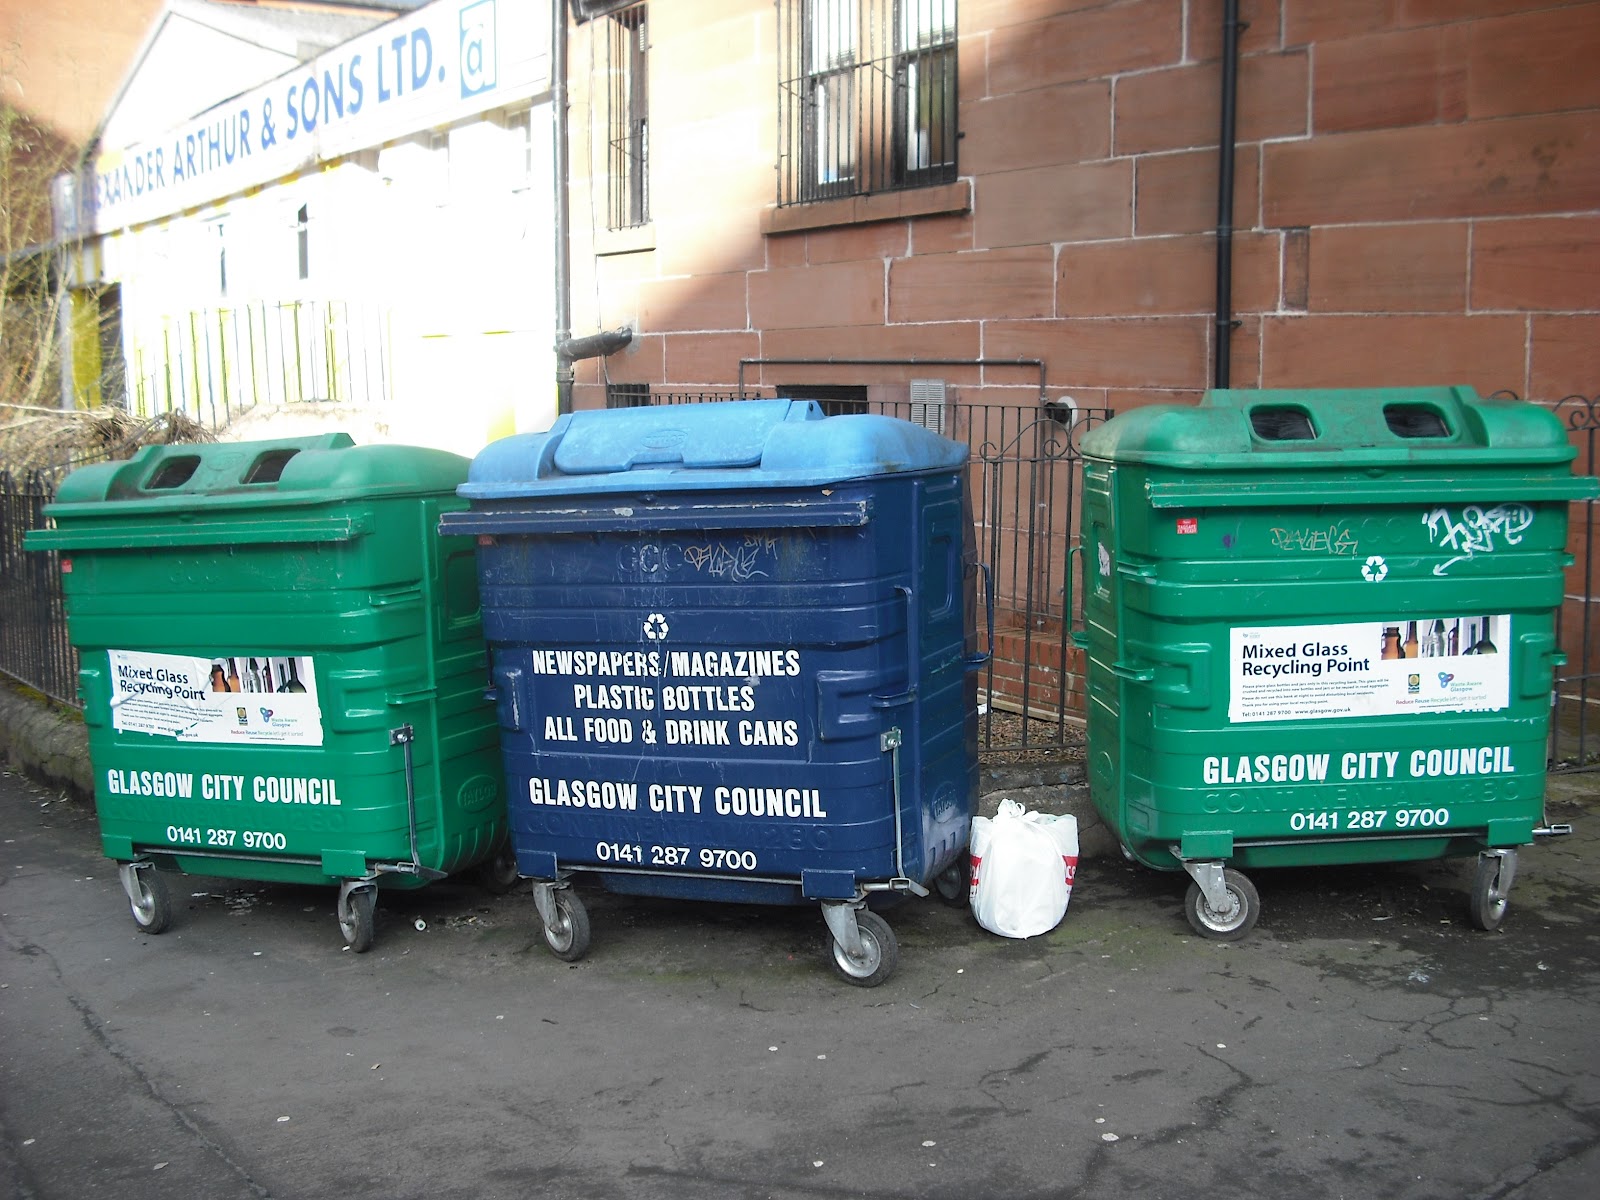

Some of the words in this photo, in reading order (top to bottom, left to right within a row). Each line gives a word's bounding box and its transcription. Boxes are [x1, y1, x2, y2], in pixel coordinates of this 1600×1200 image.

[173, 109, 251, 185] ARTHUR
[260, 97, 277, 151] &
[286, 55, 364, 139] SONS
[377, 26, 446, 104] LTD.
[532, 650, 800, 678] NEWSPAPERS/MAGAZINES
[1243, 643, 1296, 659] Mixed
[1302, 642, 1348, 657] Glass
[118, 665, 154, 680] Mixed
[156, 669, 188, 684] Glass
[1243, 659, 1322, 679] Recycling
[1327, 657, 1370, 673] Point
[574, 684, 655, 711] PLASTIC
[663, 685, 755, 712] BOTTLES
[544, 716, 578, 742] ALL
[584, 717, 633, 744] FOOD
[641, 719, 657, 744] &
[664, 719, 730, 745] DRINK
[738, 720, 799, 746] CANS
[1203, 753, 1329, 784] GLASGOW
[1341, 752, 1399, 780] CITY
[1409, 746, 1515, 778] COUNCIL
[107, 768, 193, 798] GLASGOW
[201, 773, 244, 801] CITY
[253, 776, 341, 806] COUNCIL
[529, 777, 637, 811] GLASGOW
[649, 783, 703, 814] CITY
[714, 786, 827, 818] COUNCIL
[1290, 811, 1338, 831] 0141
[1347, 810, 1387, 829] 287
[1395, 807, 1449, 827] 9700
[167, 825, 201, 844] 0141
[207, 828, 237, 846] 287
[243, 830, 286, 850] 9700
[596, 841, 643, 863] 0141
[651, 845, 690, 866] 287
[700, 849, 757, 871] 9700
